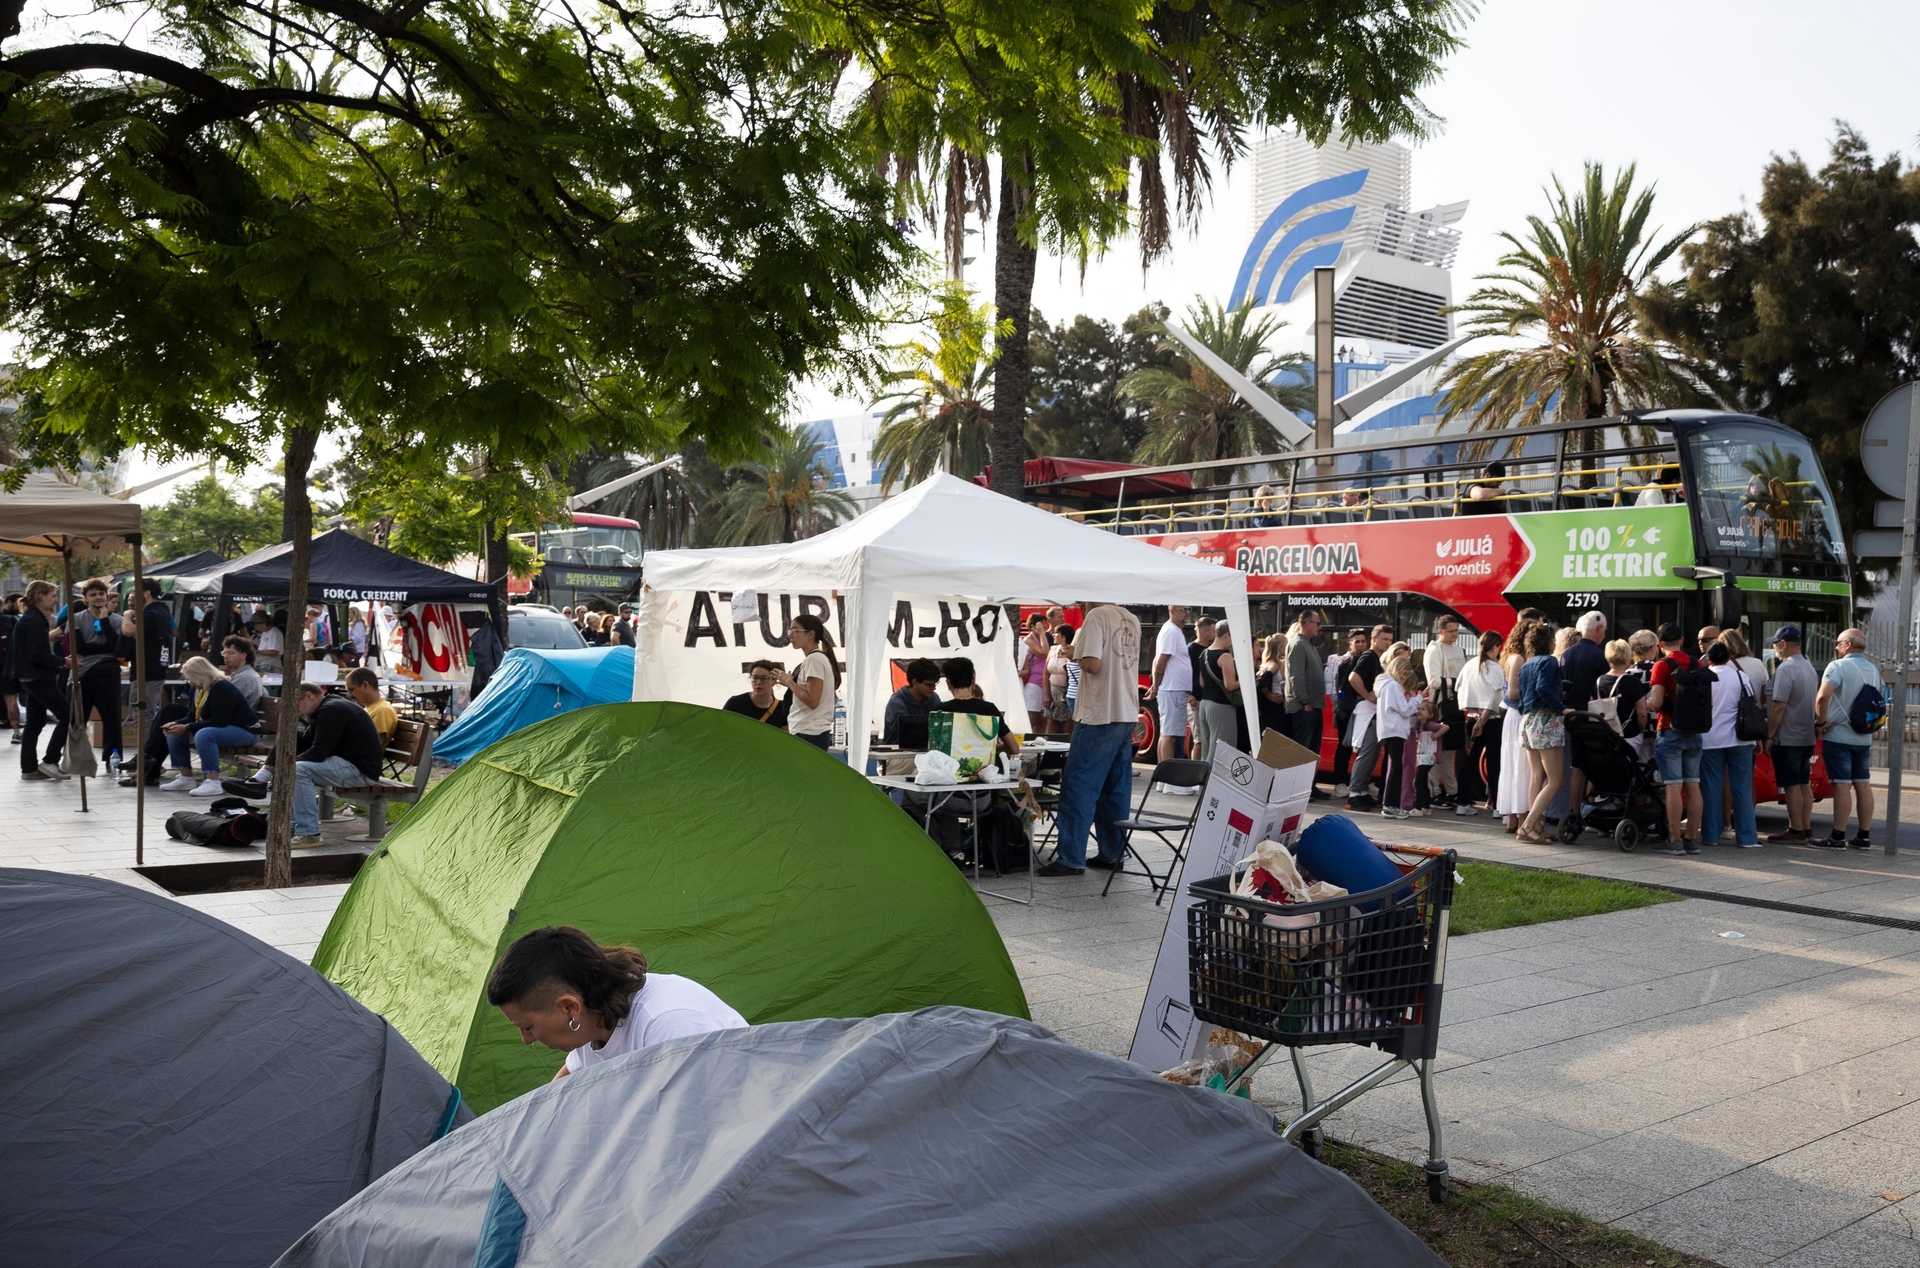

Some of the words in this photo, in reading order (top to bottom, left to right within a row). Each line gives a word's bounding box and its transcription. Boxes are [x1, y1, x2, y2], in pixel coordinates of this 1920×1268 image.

[1565, 527, 1611, 552] 100
[1236, 542, 1361, 576] BARCELONA
[1562, 552, 1668, 578] ELECTRIC
[1434, 560, 1492, 576] moventis
[566, 572, 622, 582] BARCELONA
[1767, 580, 1780, 590] 100
[1795, 582, 1822, 592] ELECTRIC
[323, 588, 358, 600] FORÇA
[361, 590, 409, 601] CREIXENT
[1287, 594, 1389, 608] barcelona.city-tour.com
[1566, 593, 1600, 608] 2579
